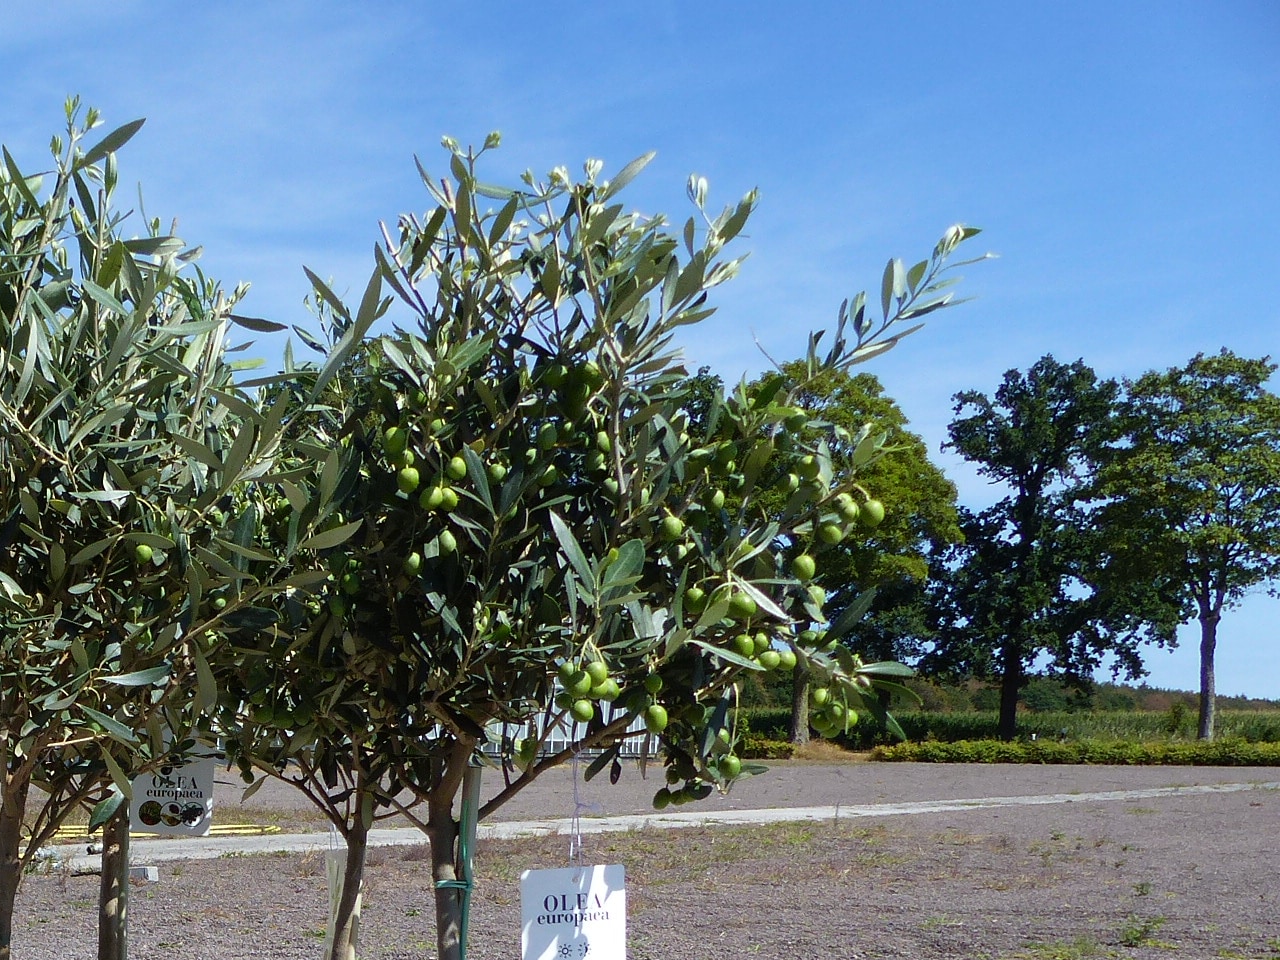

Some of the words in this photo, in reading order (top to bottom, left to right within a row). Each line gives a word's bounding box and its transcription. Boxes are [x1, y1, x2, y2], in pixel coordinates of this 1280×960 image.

[146, 789, 204, 801] europaea
[543, 892, 602, 912] OLEA
[537, 910, 609, 927] europaea
